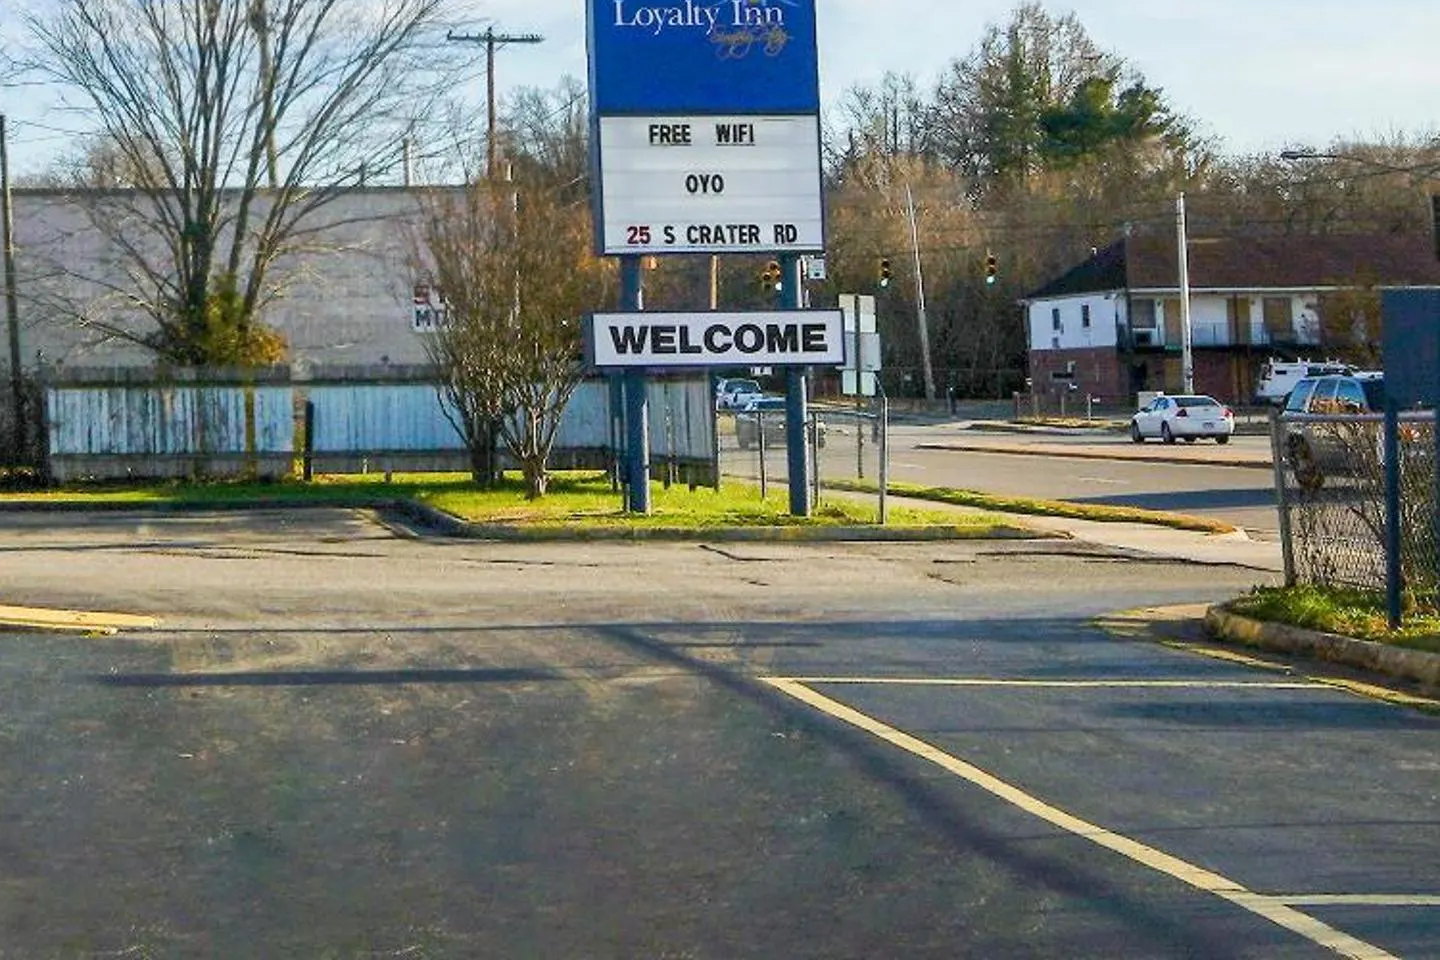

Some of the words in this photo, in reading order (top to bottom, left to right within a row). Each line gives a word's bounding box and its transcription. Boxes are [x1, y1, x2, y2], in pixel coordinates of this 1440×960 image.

[613, 0, 720, 35] Loyalty
[732, 0, 785, 26] Inn
[649, 124, 692, 144] FREE
[716, 124, 755, 144] WIFI
[685, 174, 724, 193] OYO
[627, 226, 651, 244] 25
[663, 226, 676, 244] S
[687, 225, 760, 244] CRATER
[774, 224, 797, 244] RD
[609, 323, 828, 355] WELCOME
